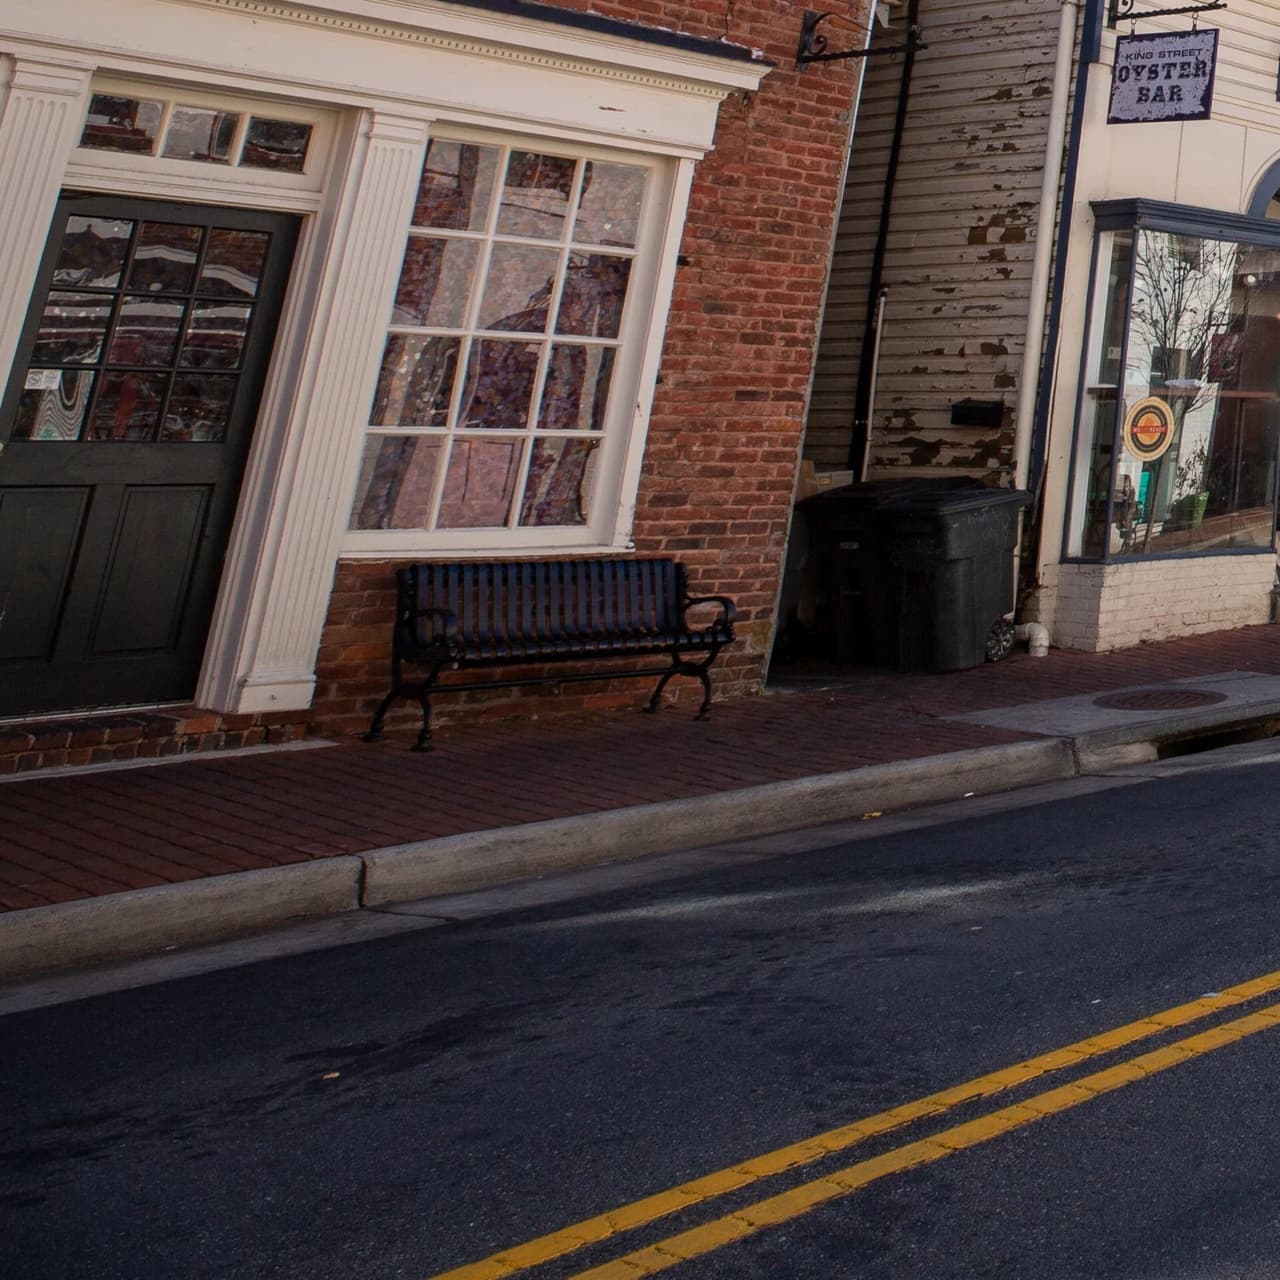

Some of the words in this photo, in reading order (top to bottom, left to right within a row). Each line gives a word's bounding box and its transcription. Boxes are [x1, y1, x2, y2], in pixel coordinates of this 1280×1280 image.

[1126, 51, 1153, 61] KING
[1158, 48, 1203, 58] STREET
[1118, 61, 1207, 82] OYSTER
[1136, 85, 1183, 104] BAR
